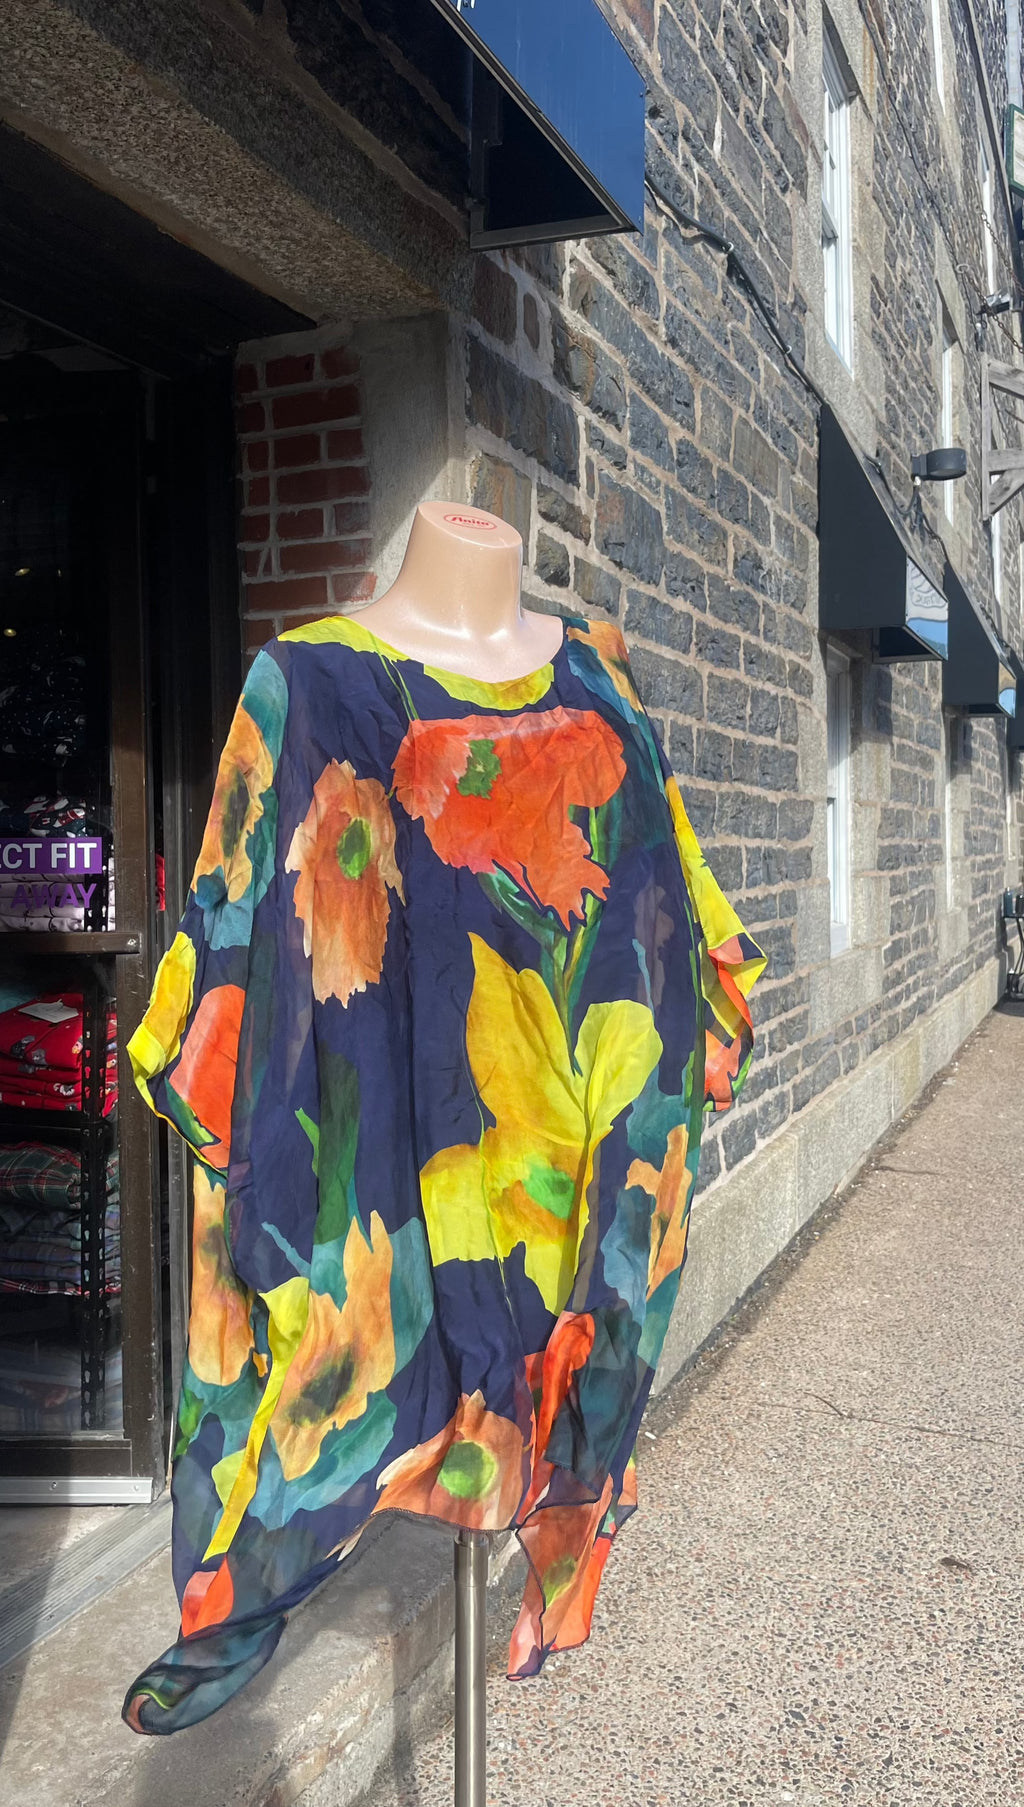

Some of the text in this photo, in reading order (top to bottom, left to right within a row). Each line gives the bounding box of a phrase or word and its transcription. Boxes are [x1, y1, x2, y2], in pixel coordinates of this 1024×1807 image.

[0, 842, 98, 869] CT FIT
[10, 883, 98, 909] AWAY
